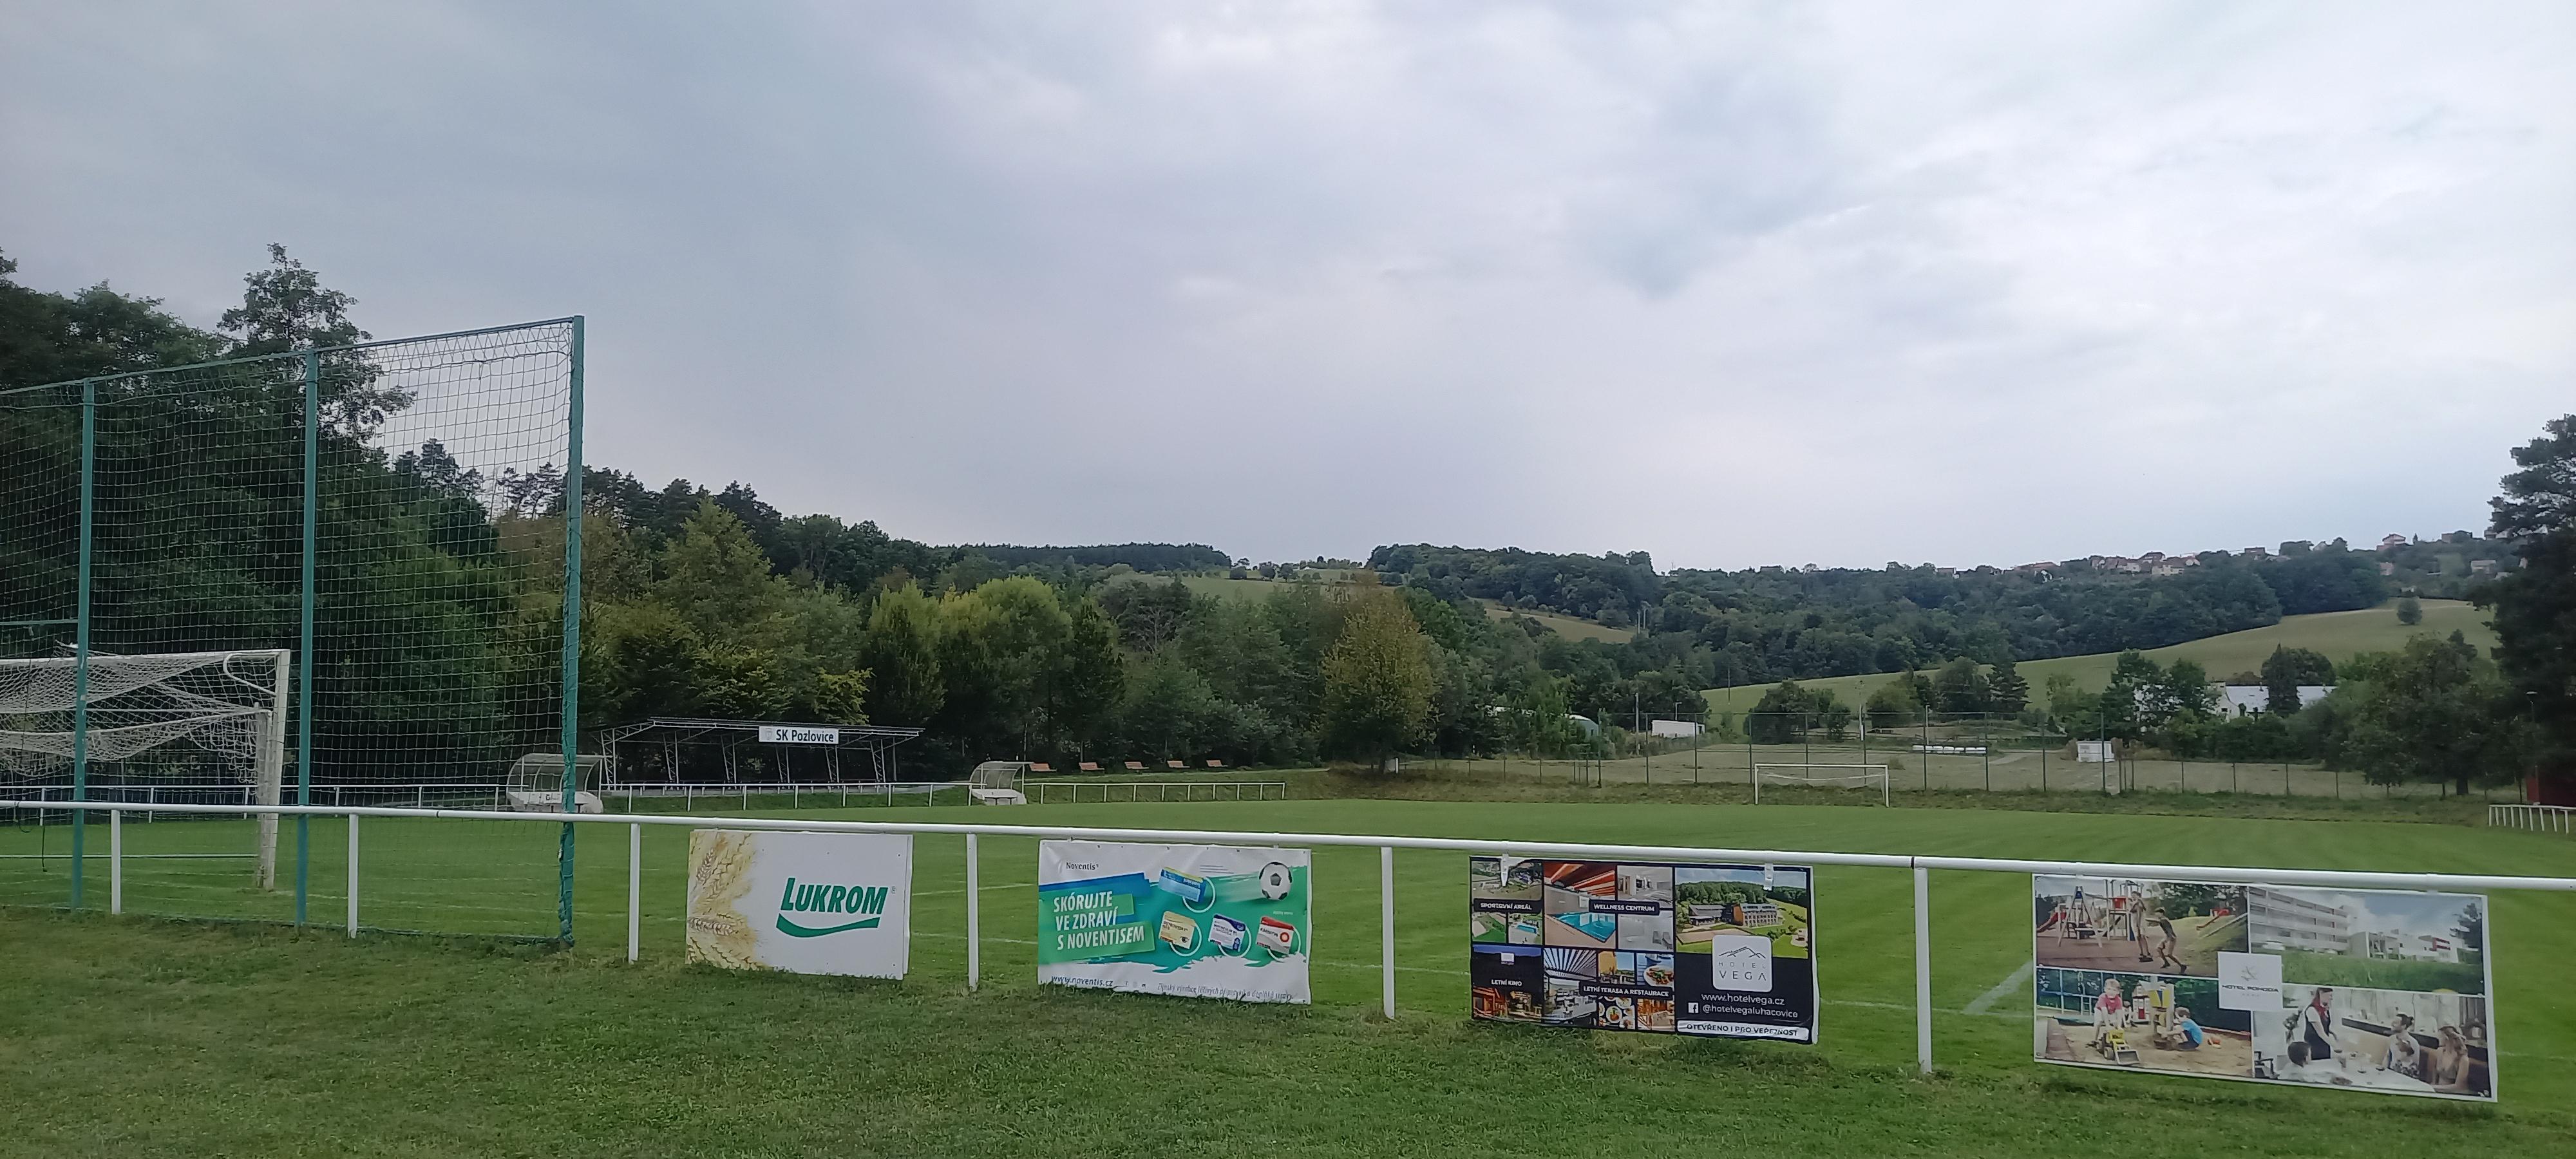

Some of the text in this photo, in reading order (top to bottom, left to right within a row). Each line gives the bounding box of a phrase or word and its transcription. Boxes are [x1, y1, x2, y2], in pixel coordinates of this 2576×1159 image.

[776, 729, 834, 742] SK Pozlovice
[1066, 862, 1096, 871] Noventis
[780, 877, 889, 915] LUKROM
[1053, 890, 1113, 913] SKÓRUJTE
[1056, 905, 1119, 932] VE ZDRAVÍ
[1057, 934, 1065, 950] S
[1067, 925, 1144, 950] NOVENTISEM
[1051, 975, 1113, 987] www.noventis.cz
[1719, 970, 1766, 982] VEGA
[1701, 993, 1785, 1006] www.hotelvega.cz
[1702, 1003, 1798, 1018] @hotelvegaluhacovice
[1687, 1023, 1729, 1032] OTEVŘENO
